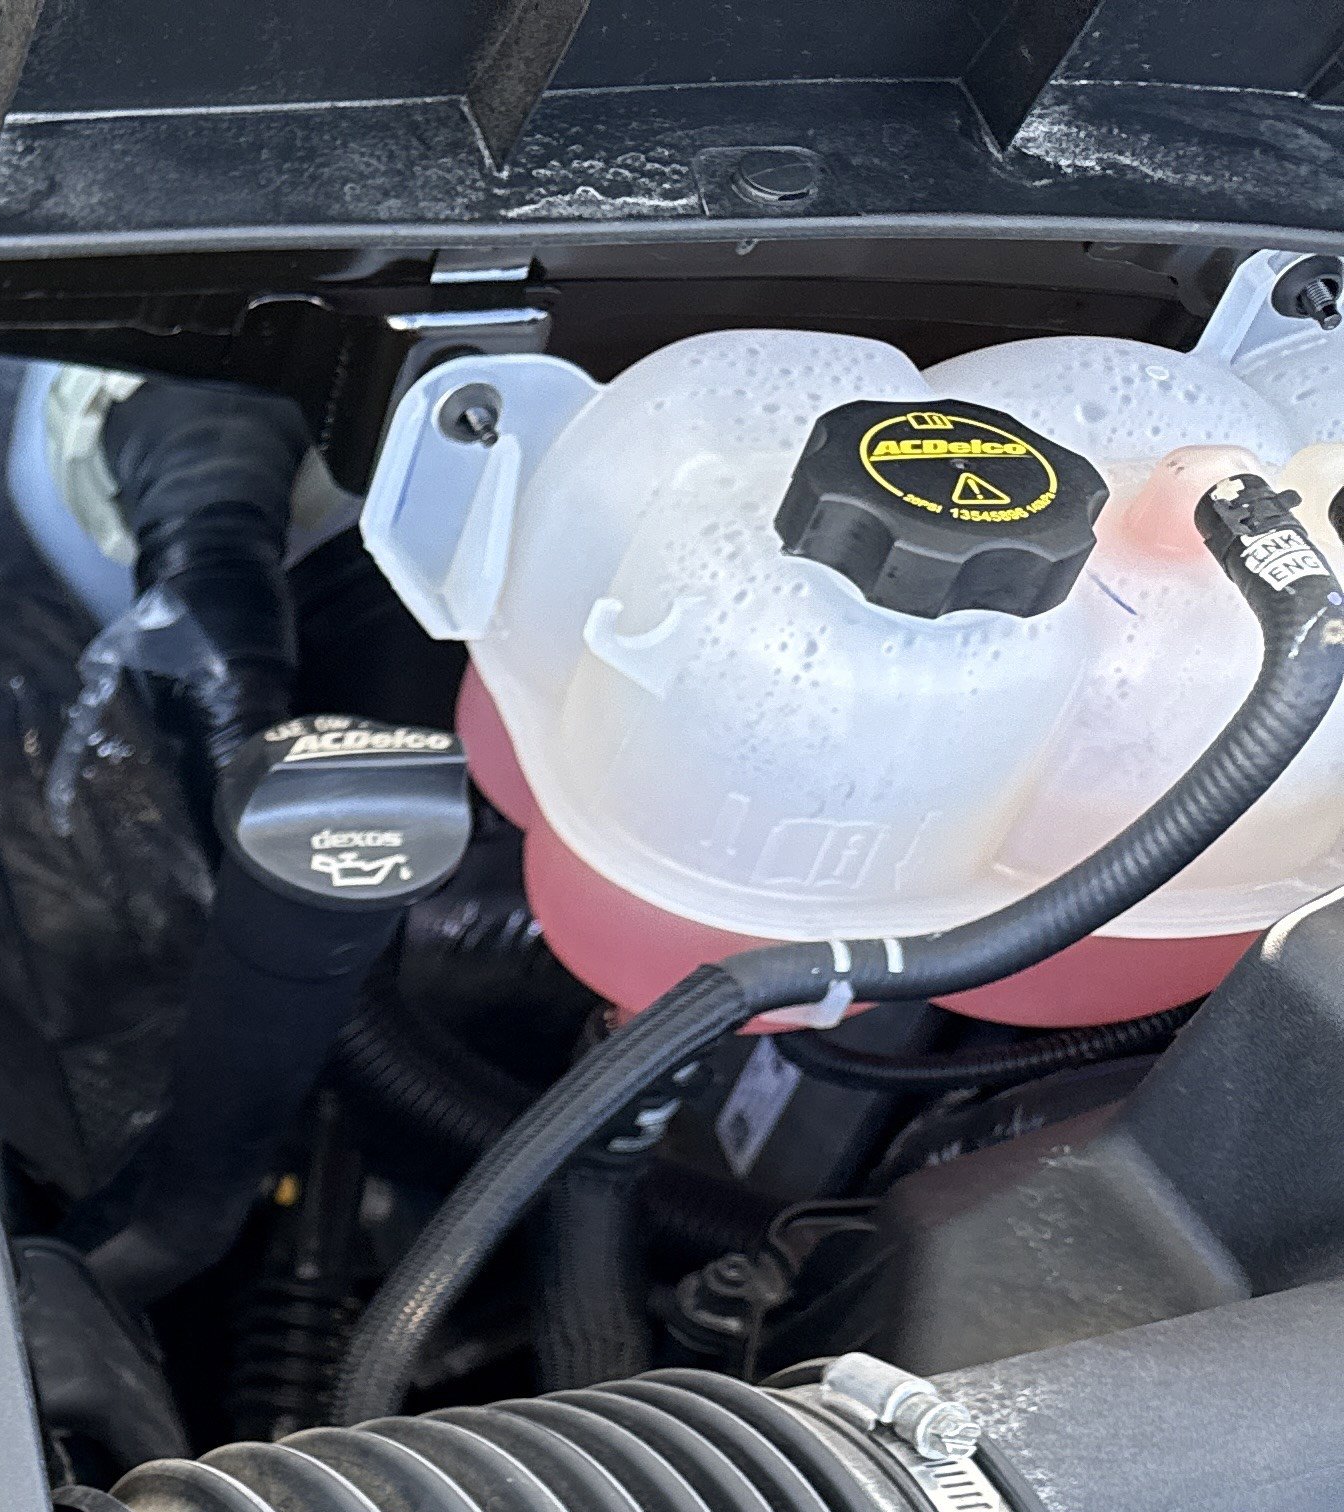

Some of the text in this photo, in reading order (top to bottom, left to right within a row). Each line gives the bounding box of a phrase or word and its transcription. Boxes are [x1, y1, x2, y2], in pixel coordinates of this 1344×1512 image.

[872, 439, 1027, 456] ACDelco
[289, 728, 454, 754] ACDelco
[311, 828, 403, 850] dexos
